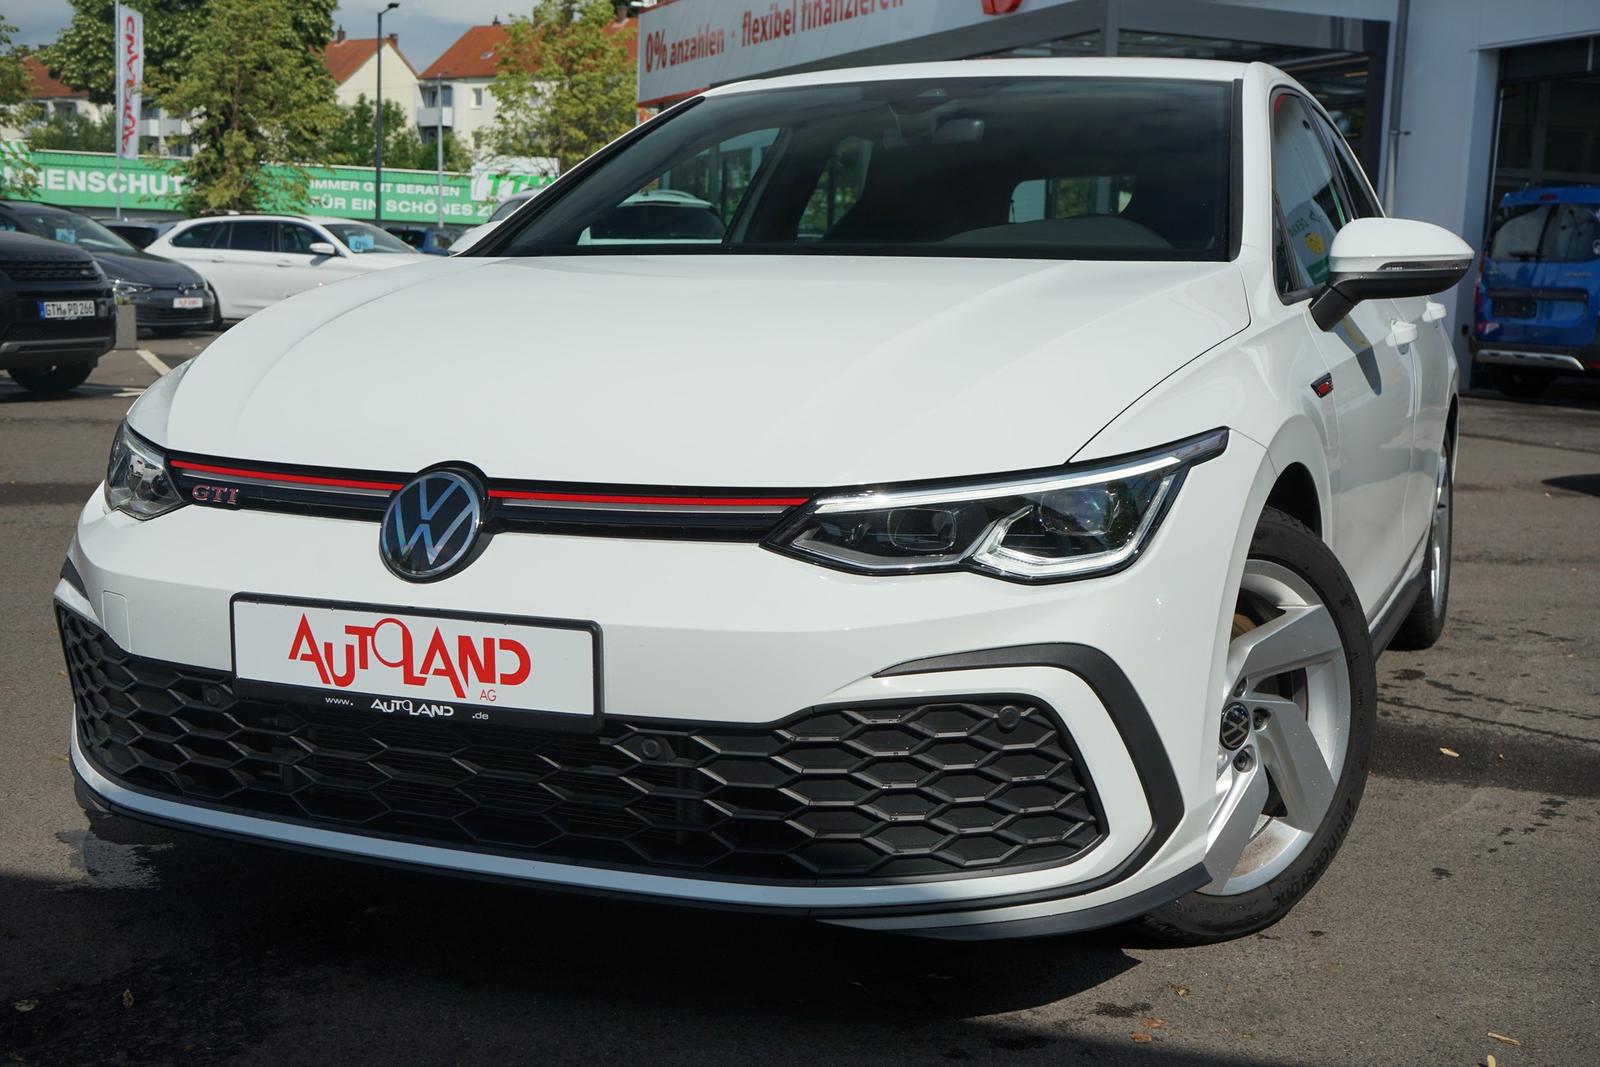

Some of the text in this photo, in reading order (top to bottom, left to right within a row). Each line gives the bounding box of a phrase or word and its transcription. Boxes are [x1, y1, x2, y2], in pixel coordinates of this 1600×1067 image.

[645, 28, 668, 74] 0%
[669, 23, 725, 67] anzahlen
[741, 0, 797, 48] flexibel
[309, 178, 360, 191] IMMER
[396, 183, 461, 197] BERATEN
[79, 302, 94, 315] 266
[192, 484, 240, 505] GTI
[288, 613, 532, 700] AUTOLAND
[479, 688, 497, 702] AG
[325, 695, 489, 721] www. AUTOLAND .de
